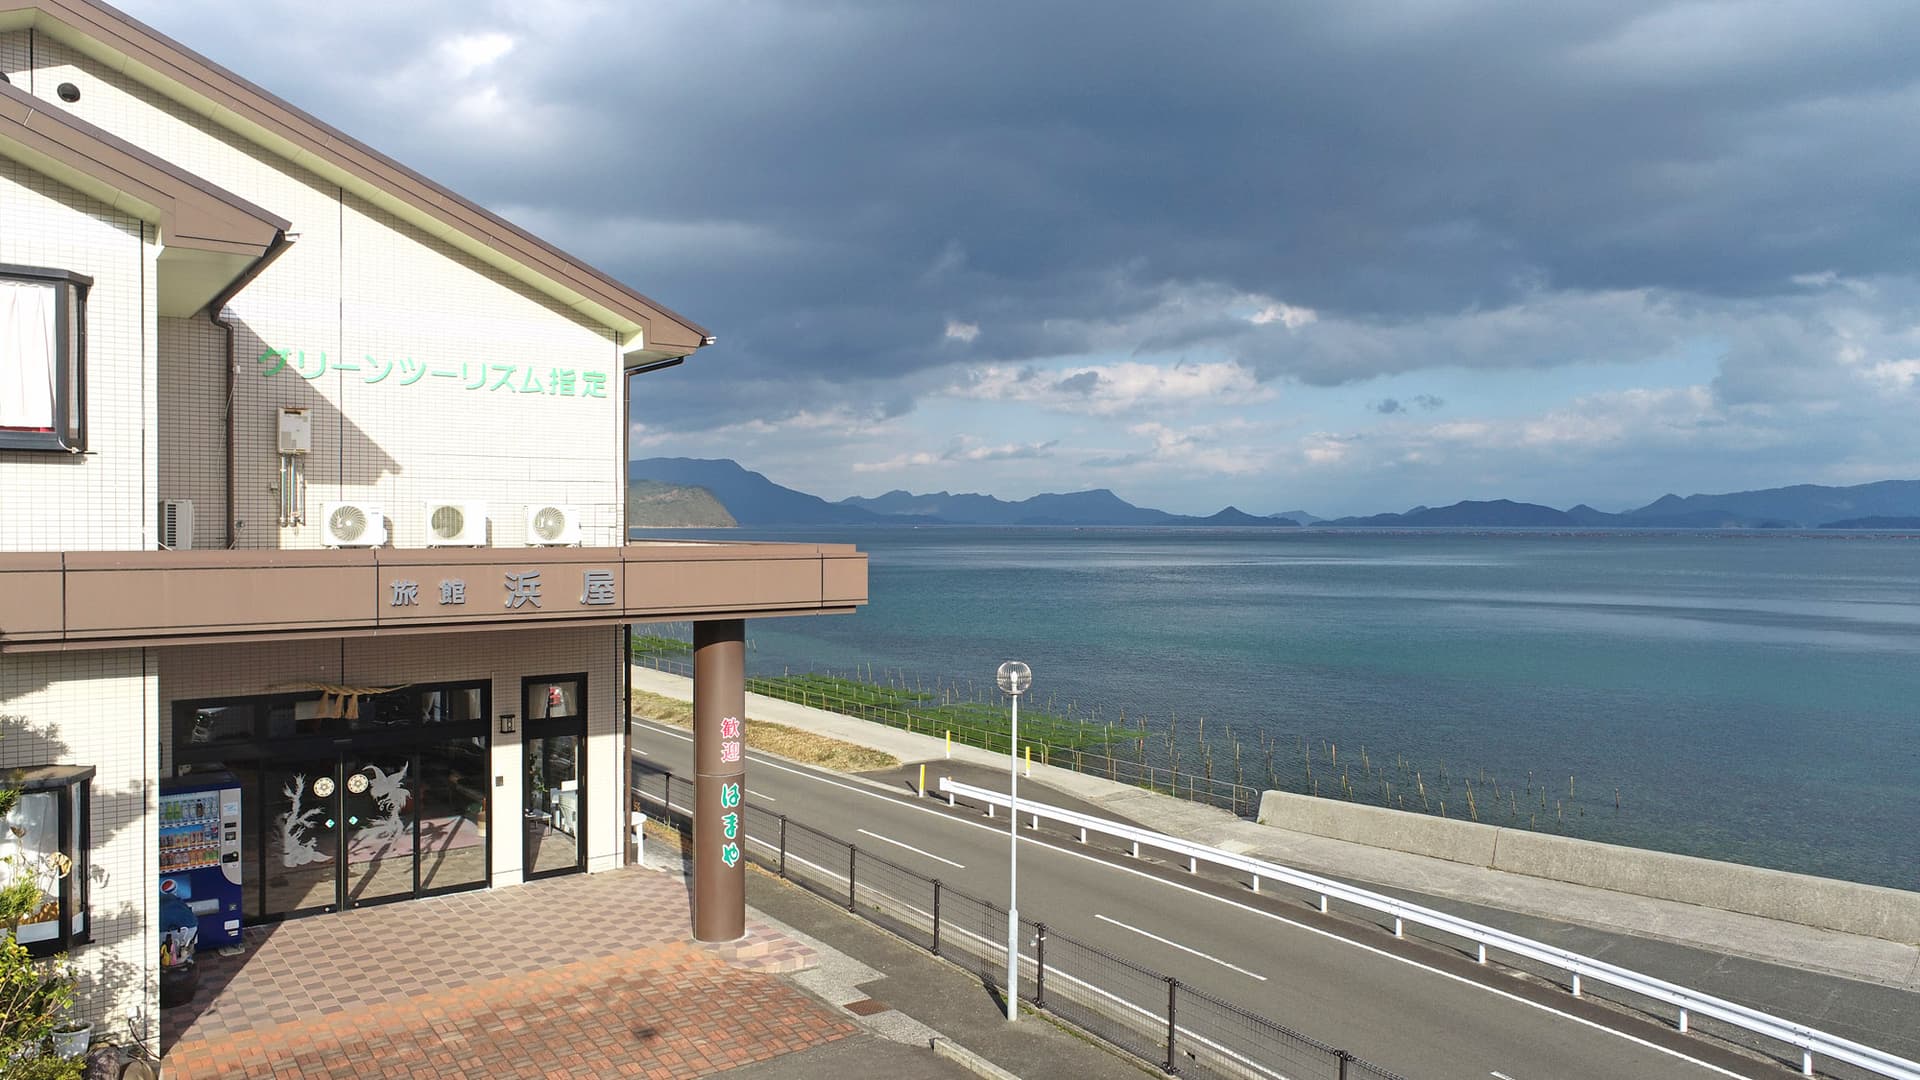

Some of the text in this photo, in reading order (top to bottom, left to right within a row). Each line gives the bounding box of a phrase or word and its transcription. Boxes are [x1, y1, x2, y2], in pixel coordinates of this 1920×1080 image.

[258, 346, 608, 398] グリーンツーリズム指定
[390, 569, 616, 608] 旅館 浜屋
[721, 717, 741, 763] 歓迎
[721, 783, 741, 868] はまや
